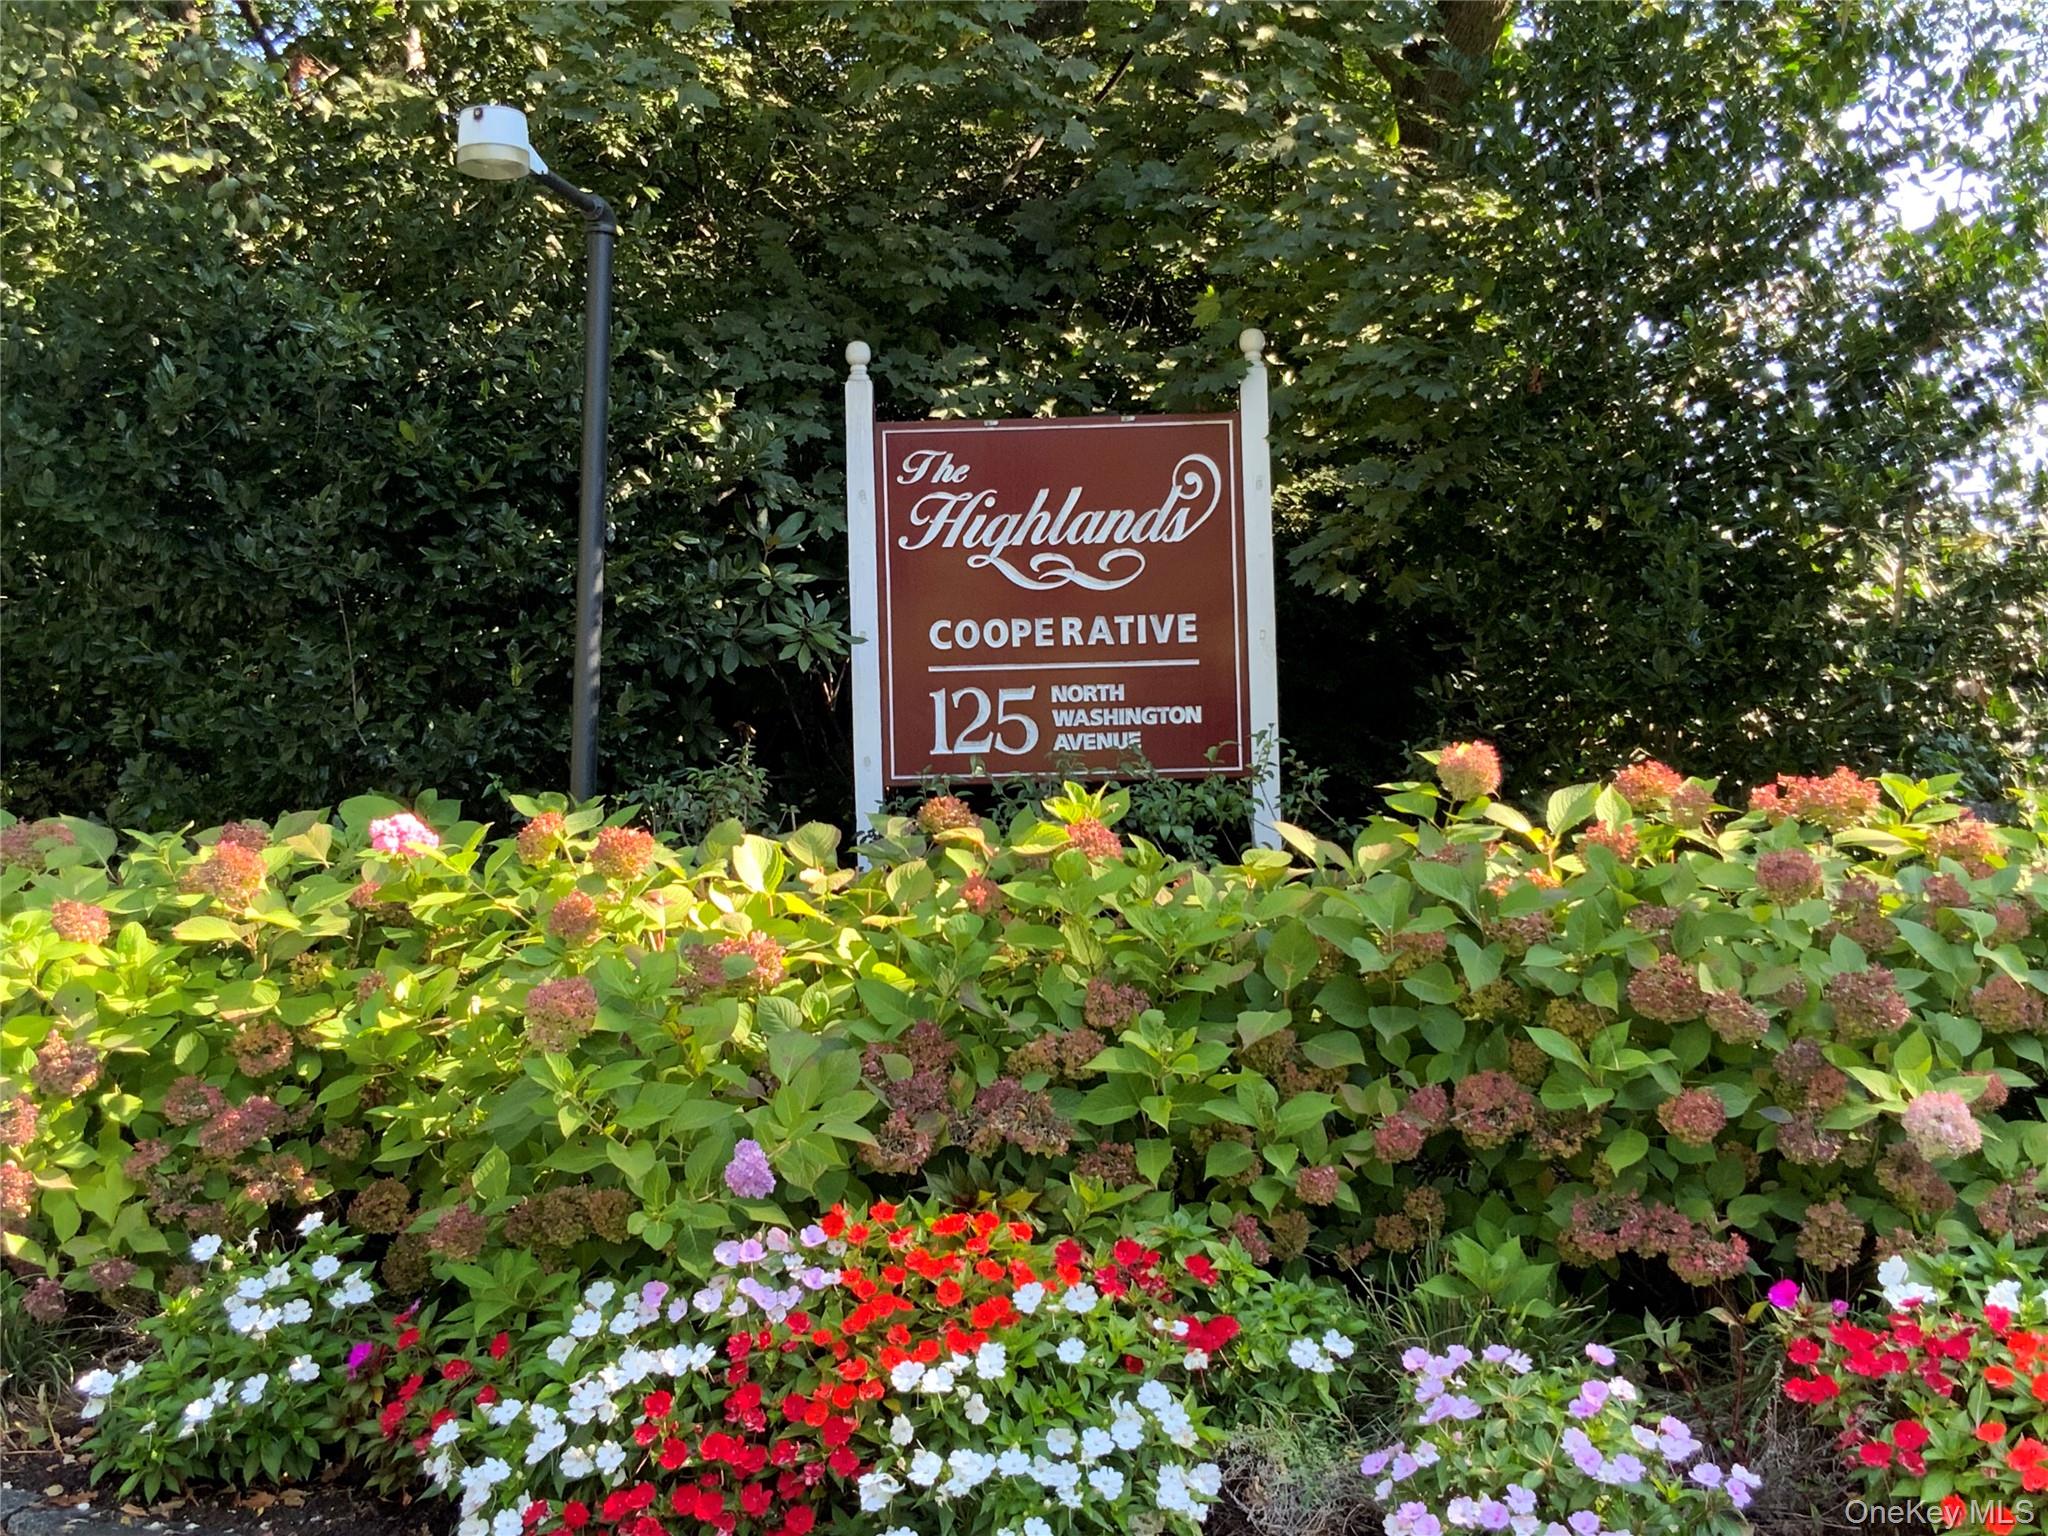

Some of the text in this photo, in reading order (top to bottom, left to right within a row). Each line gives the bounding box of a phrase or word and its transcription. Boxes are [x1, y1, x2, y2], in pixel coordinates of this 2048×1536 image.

[896, 449, 971, 485] The
[898, 453, 1222, 591] Highlands
[929, 613, 1199, 650] COOPERATIVE
[1050, 683, 1125, 703] NORTH
[929, 684, 1040, 756] 125
[1051, 705, 1203, 727] WASHINGTON
[1052, 731, 1143, 752] AVENUE
